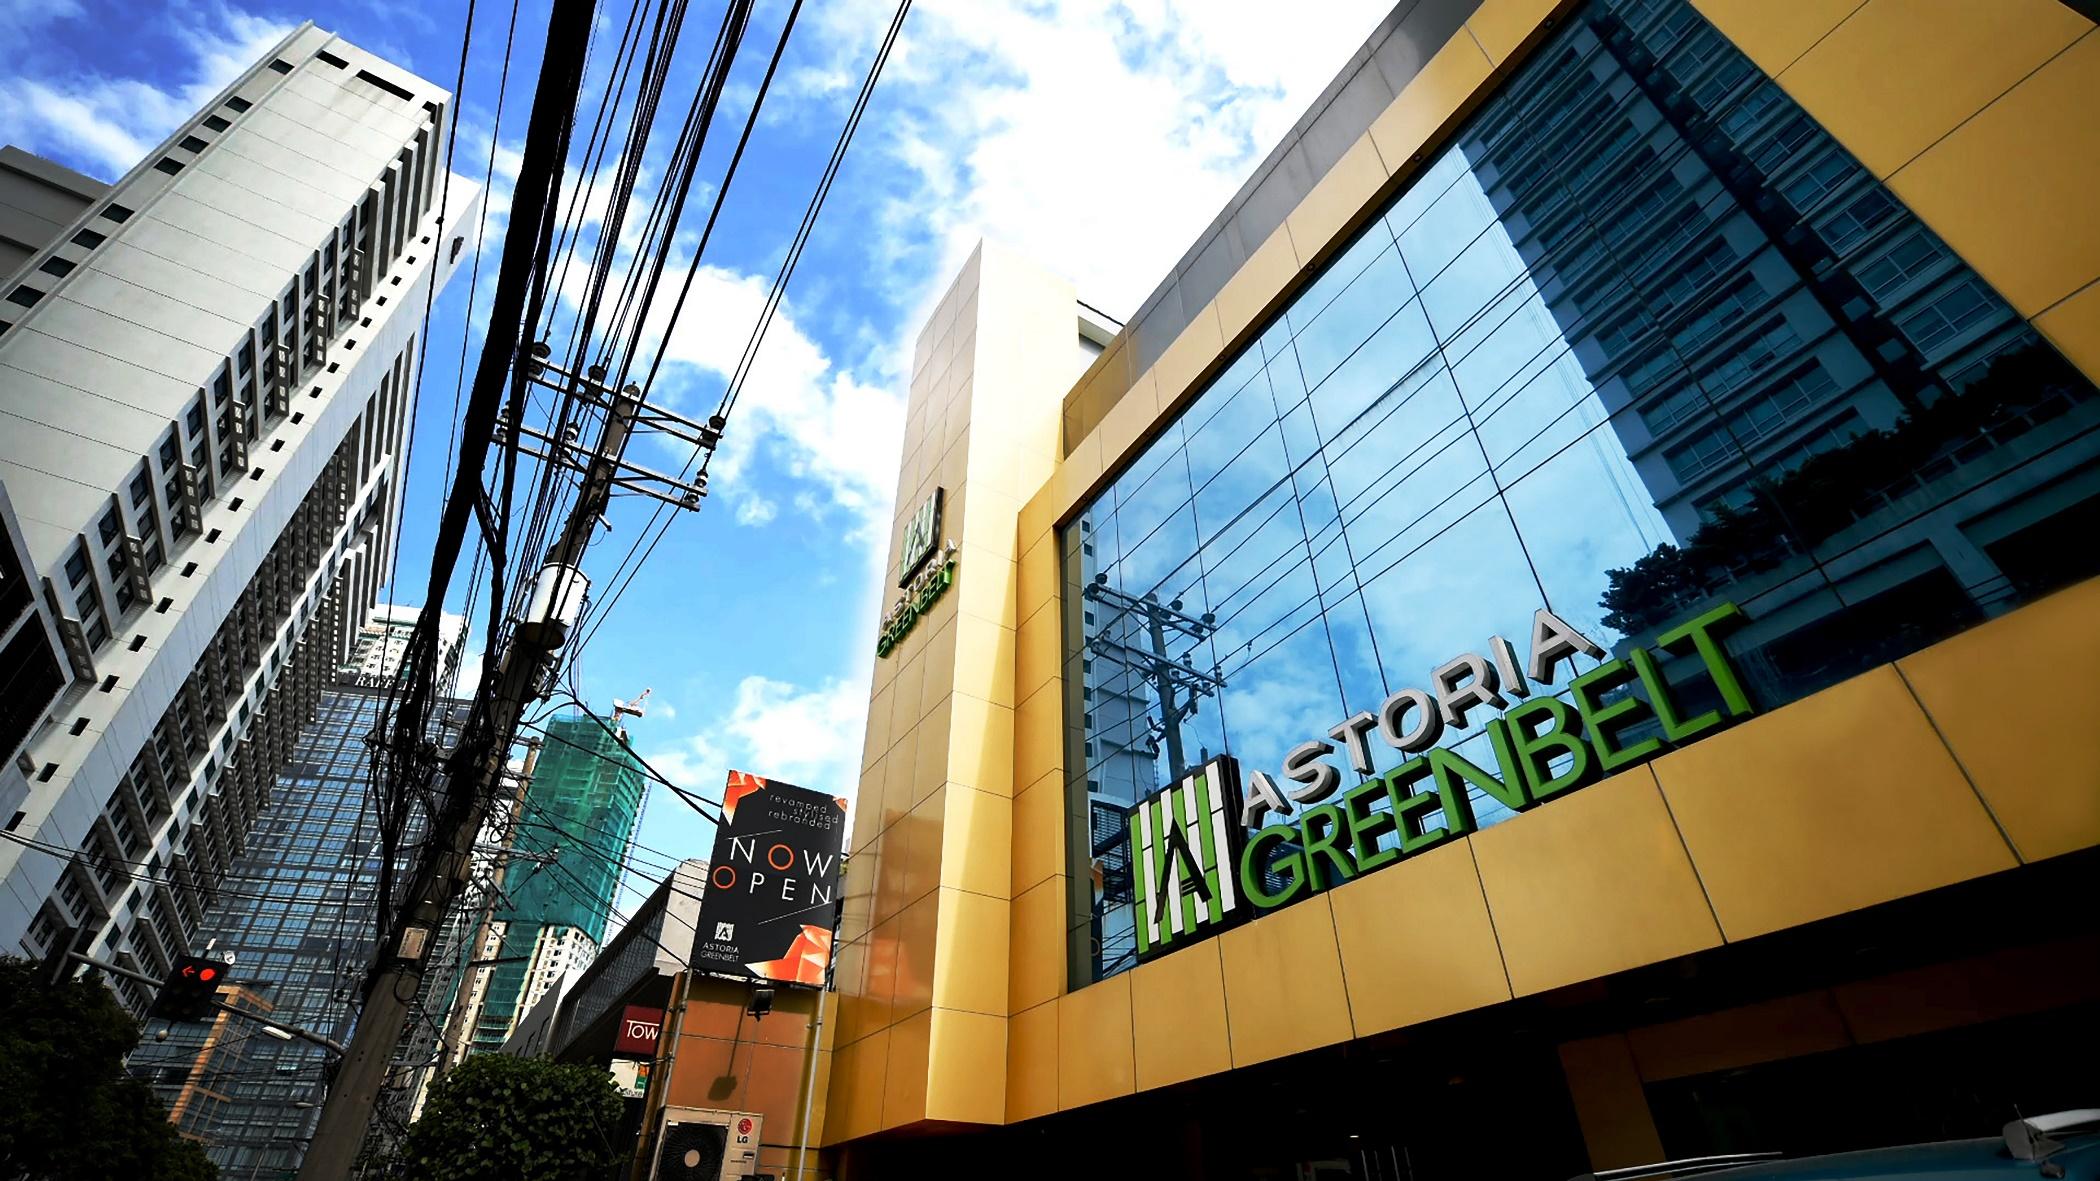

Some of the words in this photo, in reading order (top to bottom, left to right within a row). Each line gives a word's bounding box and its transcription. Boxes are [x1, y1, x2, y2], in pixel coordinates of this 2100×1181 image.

[882, 538, 957, 631] ASTORIA
[877, 558, 956, 658] GREENBELT
[1240, 608, 1606, 829] ASTORIA
[1240, 601, 1754, 910] GREENBELT
[769, 794, 827, 814] revamped
[793, 808, 839, 824] stylised
[768, 809, 831, 830] rebranded
[730, 837, 834, 878] NOW
[712, 865, 831, 904] OPEN
[700, 950, 740, 962] GREENBELT
[702, 942, 740, 954] ASTORIA
[736, 1135, 748, 1144] LG
